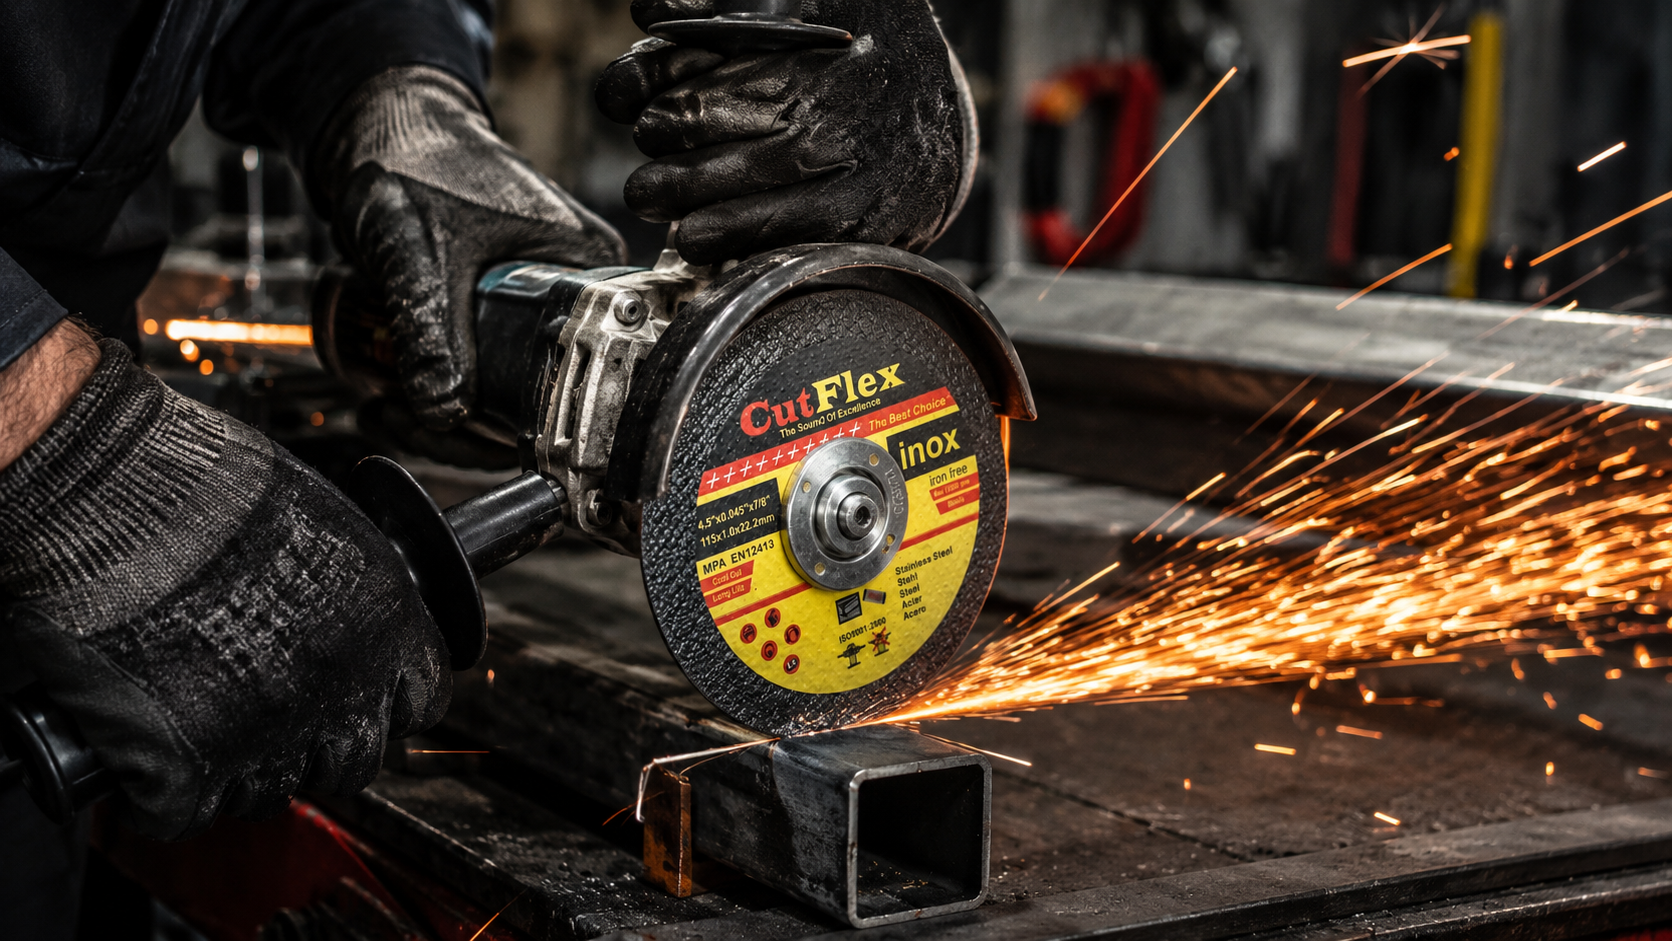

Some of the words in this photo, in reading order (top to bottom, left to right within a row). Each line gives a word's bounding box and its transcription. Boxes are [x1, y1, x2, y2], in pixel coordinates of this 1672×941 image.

[740, 363, 905, 436] CutFlex
[889, 409, 911, 423] Best
[913, 397, 946, 416] Choice
[898, 428, 961, 470] inox
[929, 473, 947, 487] iron
[949, 464, 968, 478] free
[703, 558, 727, 575] MPA
[730, 539, 775, 564] EN12413
[895, 556, 932, 575] Stainless
